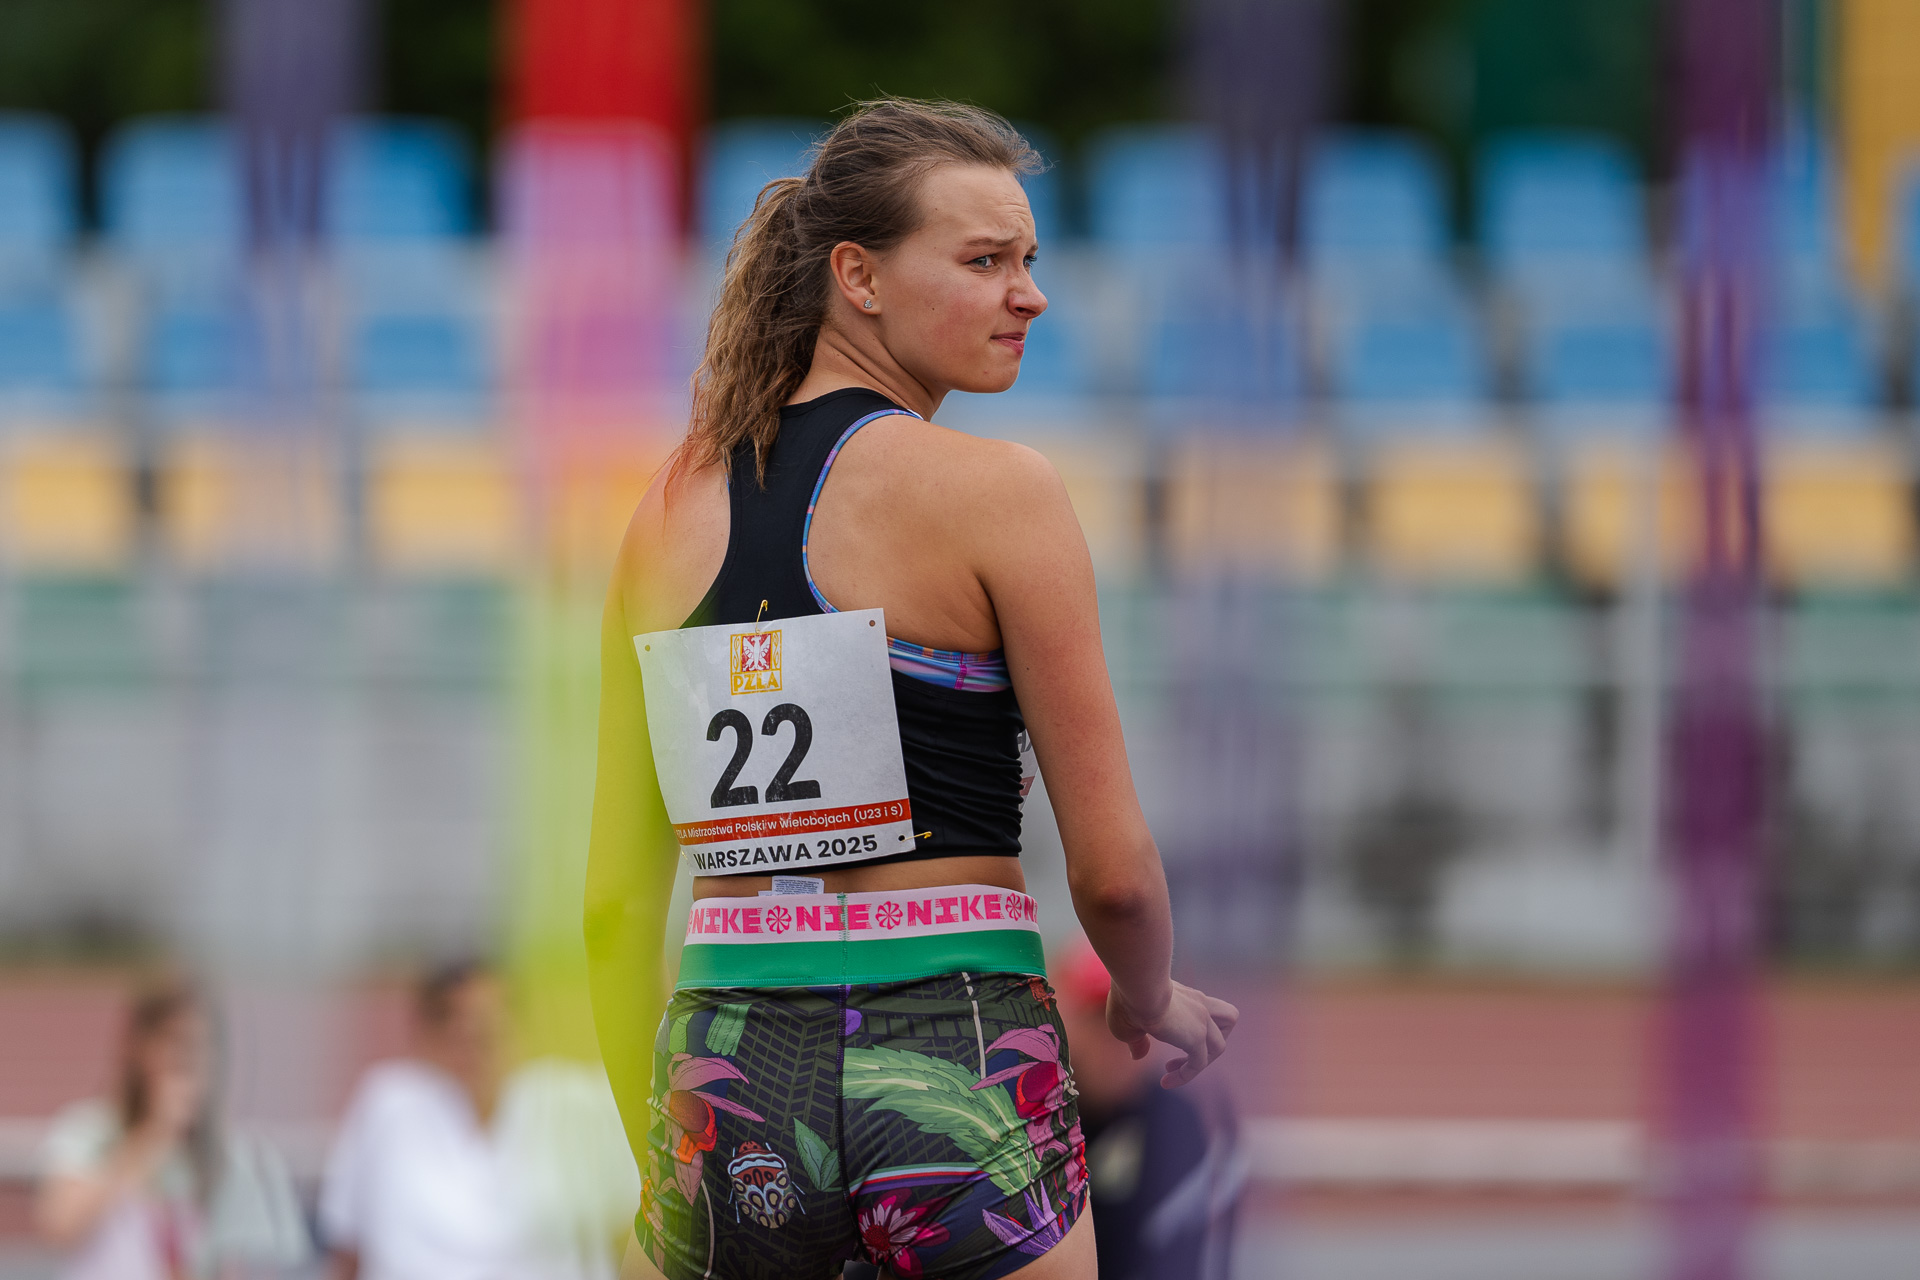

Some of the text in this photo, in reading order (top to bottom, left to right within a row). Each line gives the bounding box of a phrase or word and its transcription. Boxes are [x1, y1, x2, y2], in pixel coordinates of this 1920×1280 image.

[733, 671, 779, 692] PZLA
[706, 703, 821, 808] 22
[688, 825, 733, 838] Mistrzostwa
[735, 820, 765, 832] Polski
[767, 821, 777, 830] w
[853, 808, 881, 823] (U23
[884, 806, 888, 817] i
[890, 802, 904, 816] S)
[693, 834, 878, 870] WARSZAWA 2025
[691, 907, 764, 934] NIKE
[907, 893, 1006, 927] NIKE
